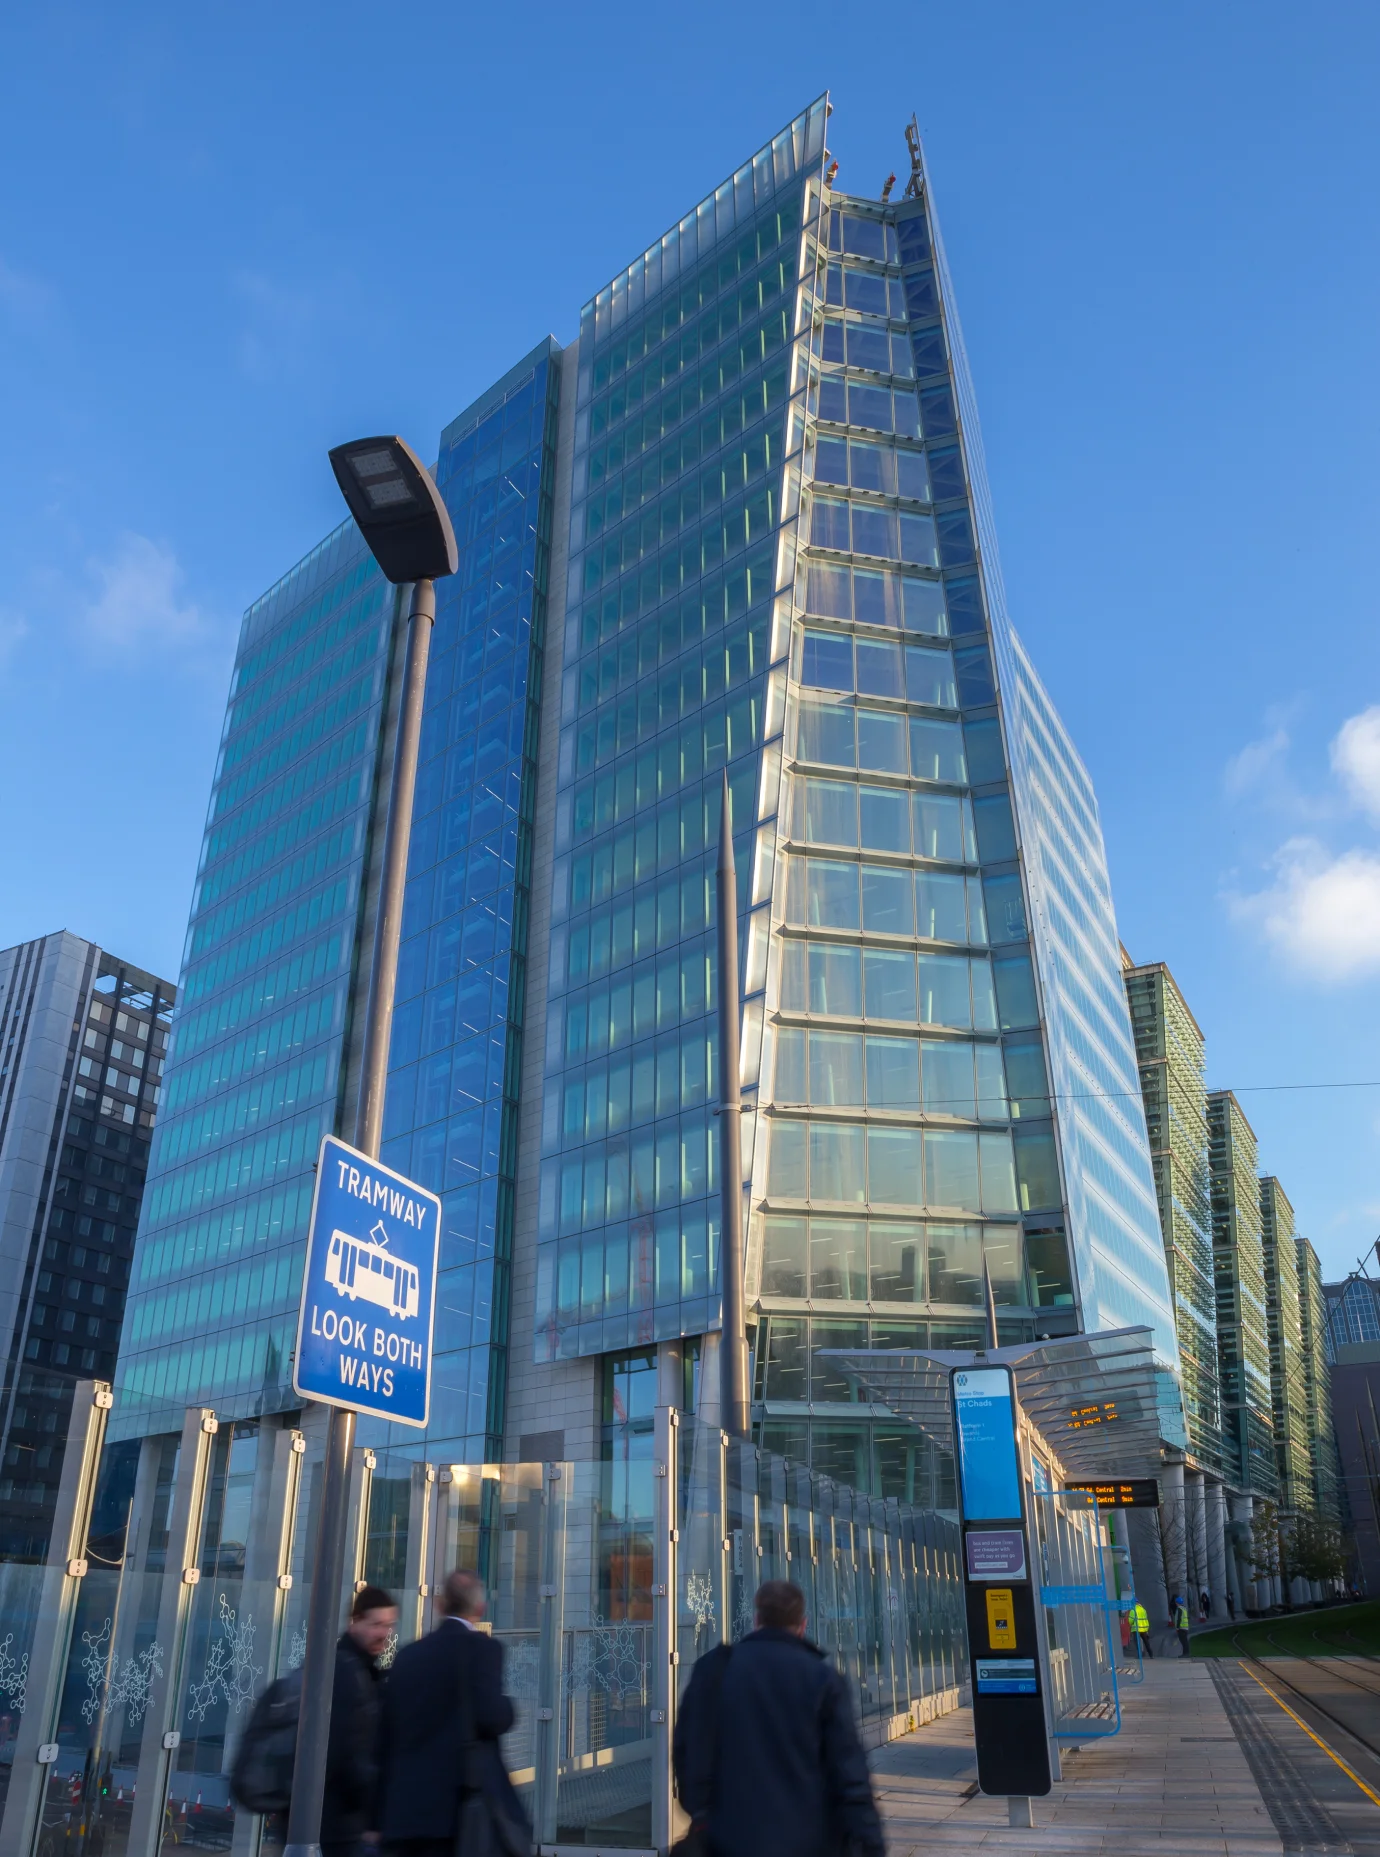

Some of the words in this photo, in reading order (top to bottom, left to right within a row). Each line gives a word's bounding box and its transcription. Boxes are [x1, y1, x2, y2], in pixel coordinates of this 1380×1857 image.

[337, 1160, 426, 1230] TRAMWAY
[311, 1305, 368, 1351] LOOK
[373, 1328, 422, 1370] BOTH
[340, 1354, 394, 1397] WAYS
[967, 1400, 992, 1408] Chads
